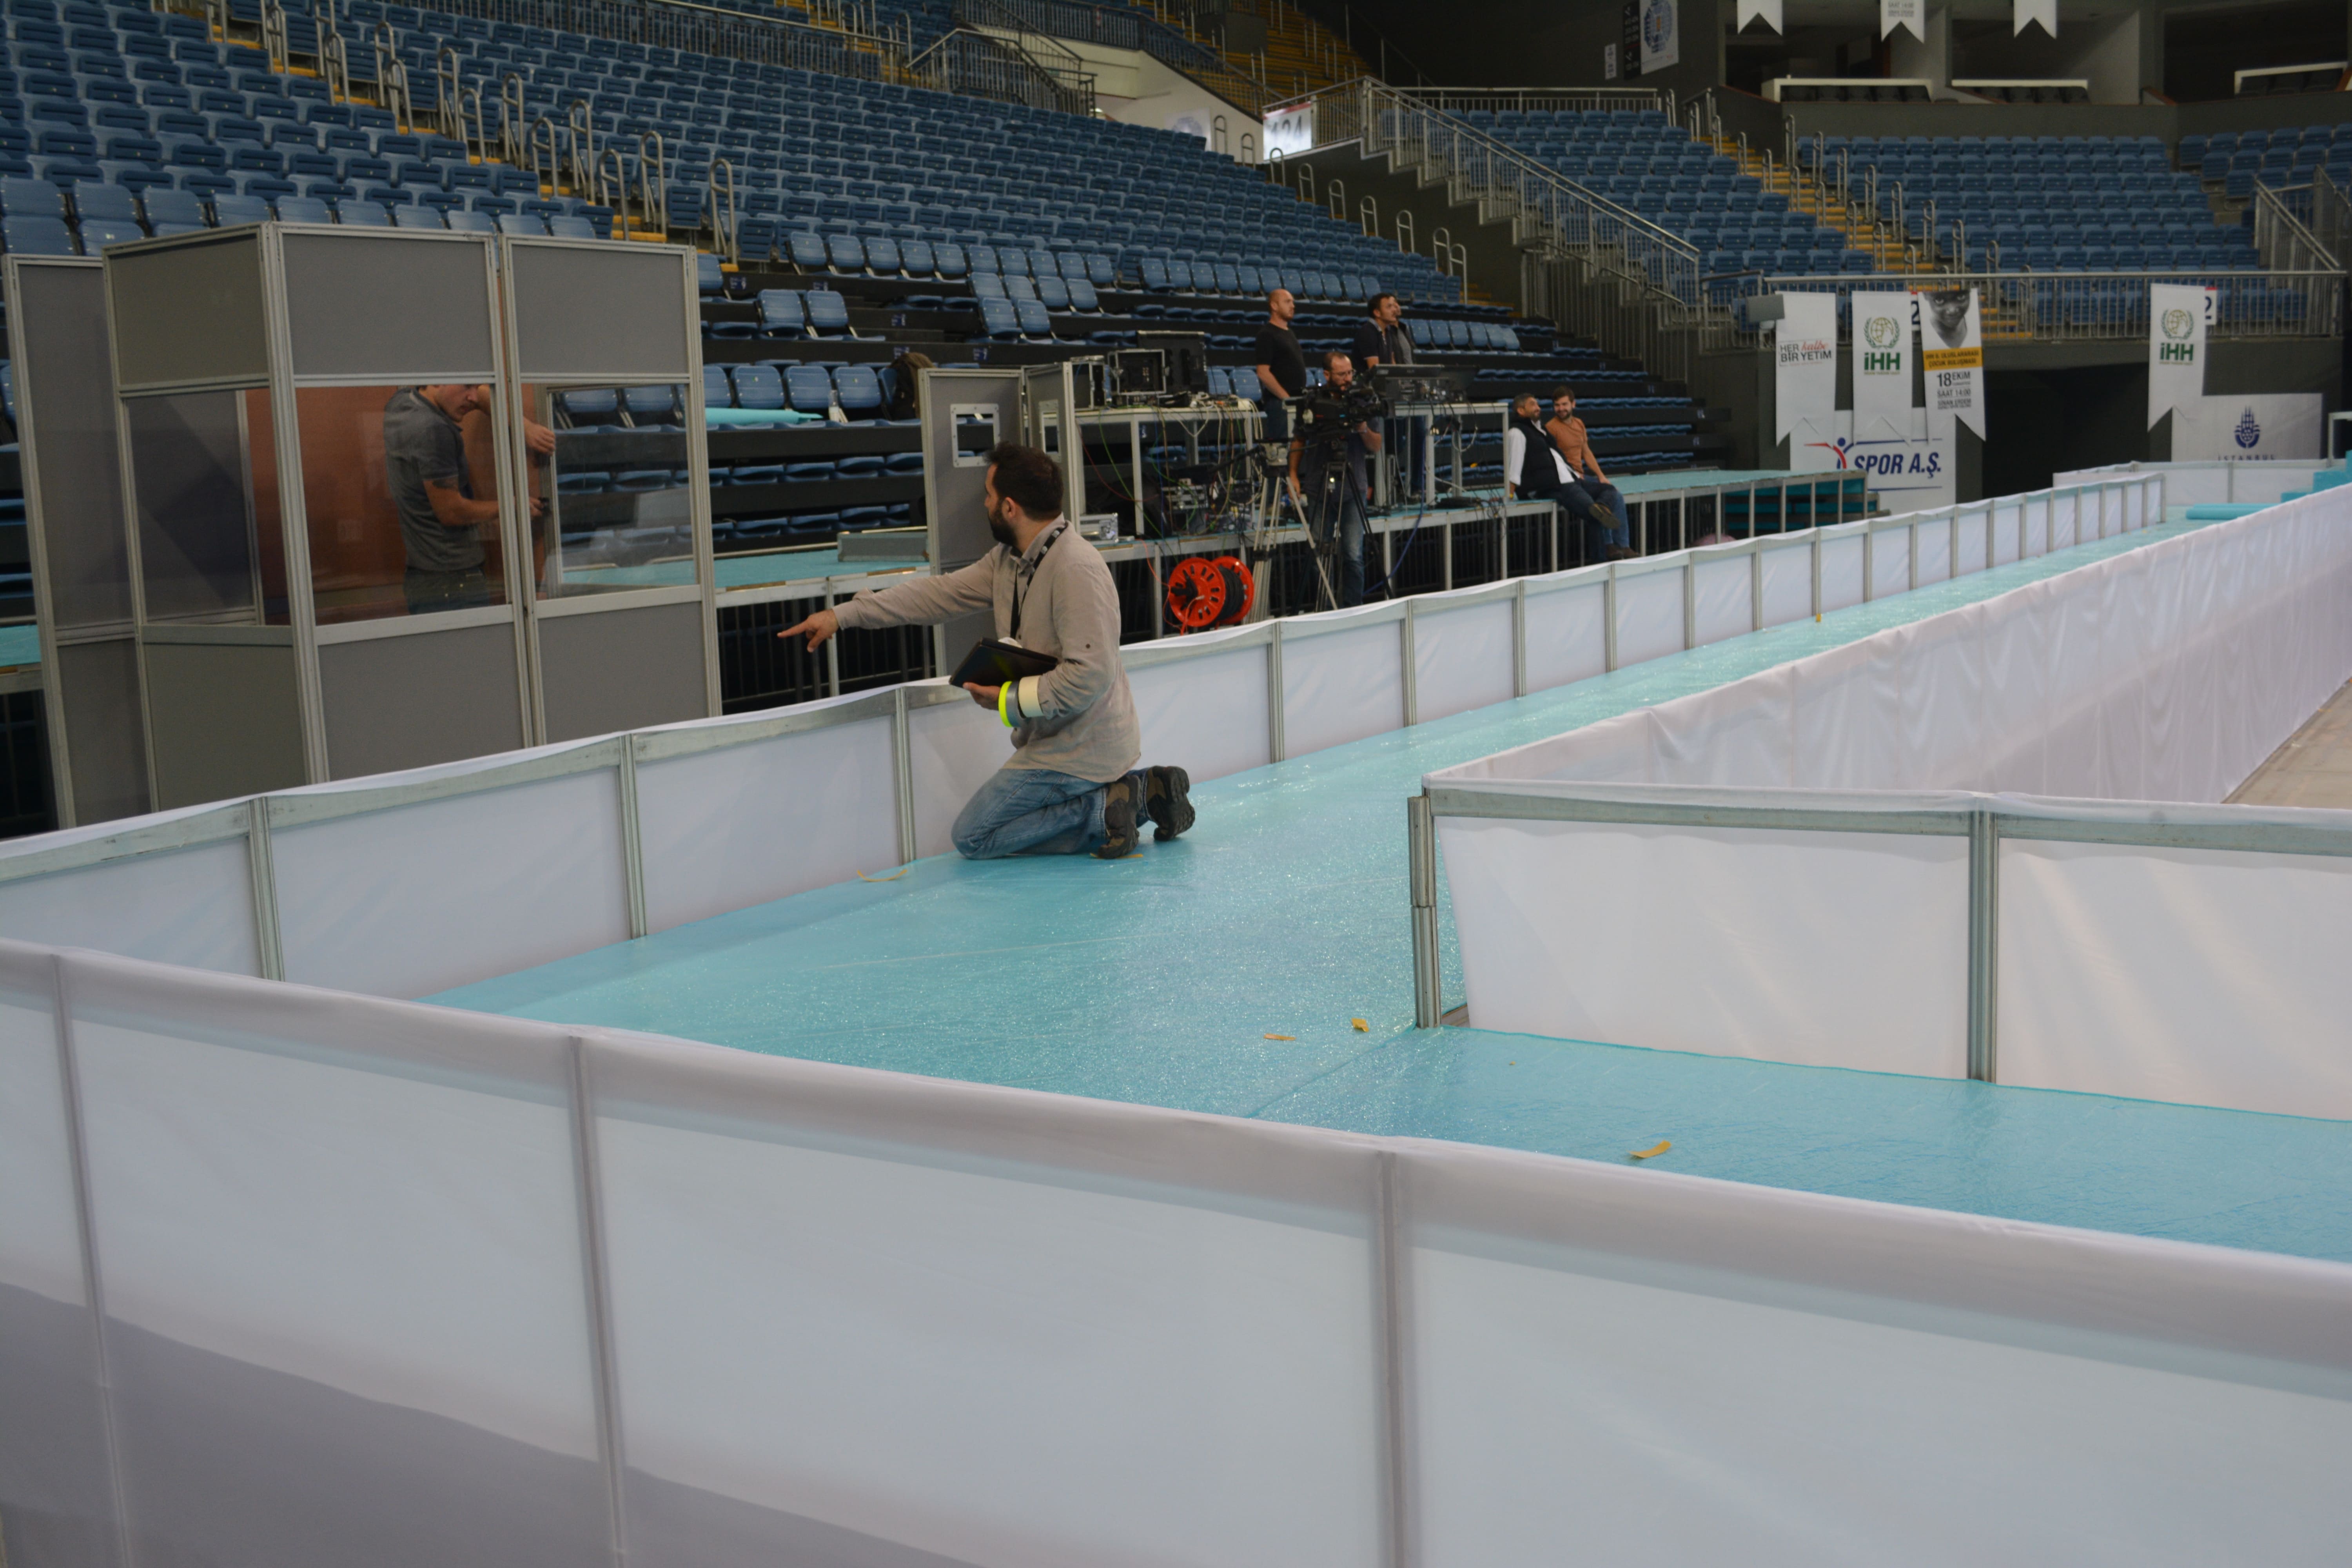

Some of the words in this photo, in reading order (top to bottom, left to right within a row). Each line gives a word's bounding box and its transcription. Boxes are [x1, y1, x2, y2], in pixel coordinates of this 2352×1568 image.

[1780, 343, 1799, 352] HER
[1936, 372, 1952, 387] 18
[1937, 389, 1953, 397] SAAT
[1855, 454, 1903, 475] SPOR
